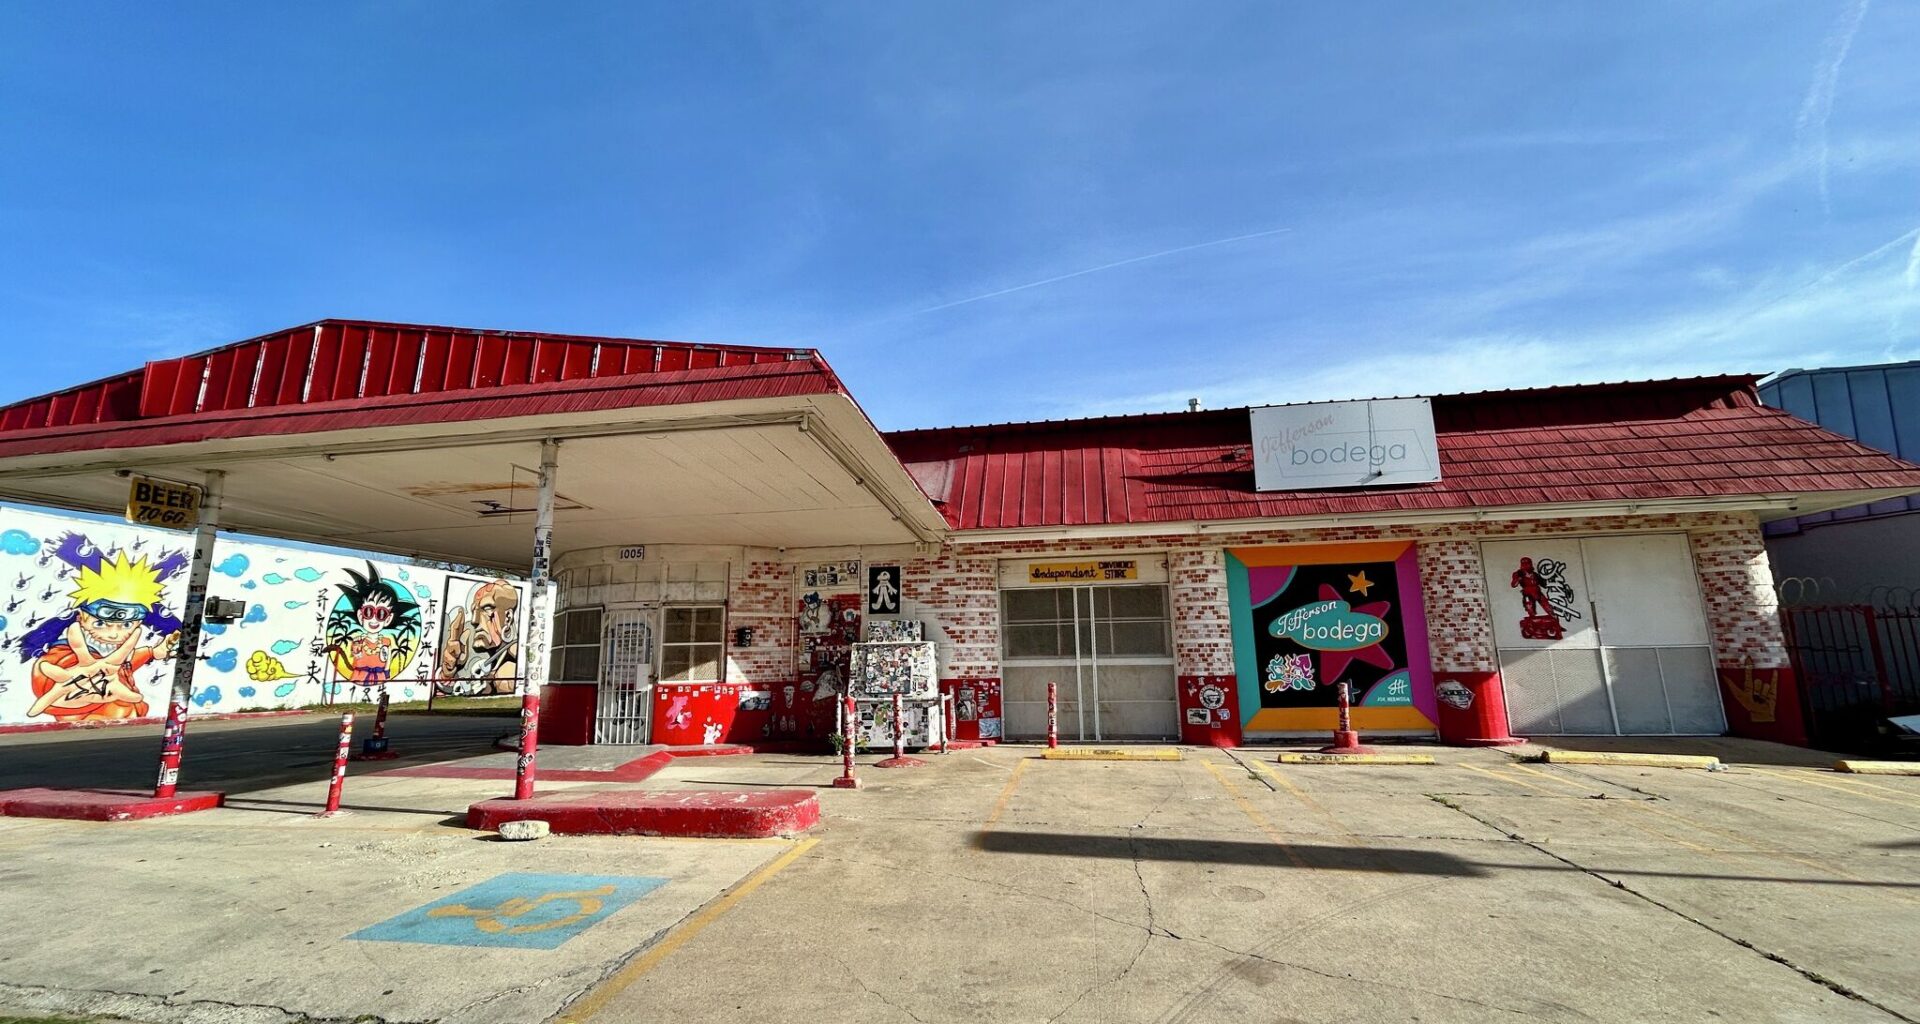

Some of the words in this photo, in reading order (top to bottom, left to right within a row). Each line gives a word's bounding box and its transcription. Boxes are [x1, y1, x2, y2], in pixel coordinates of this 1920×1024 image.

[1260, 413, 1335, 463] Jefferson
[1291, 442, 1406, 466] bodega
[135, 482, 194, 510] BEER
[620, 548, 642, 559] 1005
[1031, 565, 1098, 582] Independent
[1277, 600, 1337, 636] Jefferson
[1303, 619, 1382, 642] bodega
